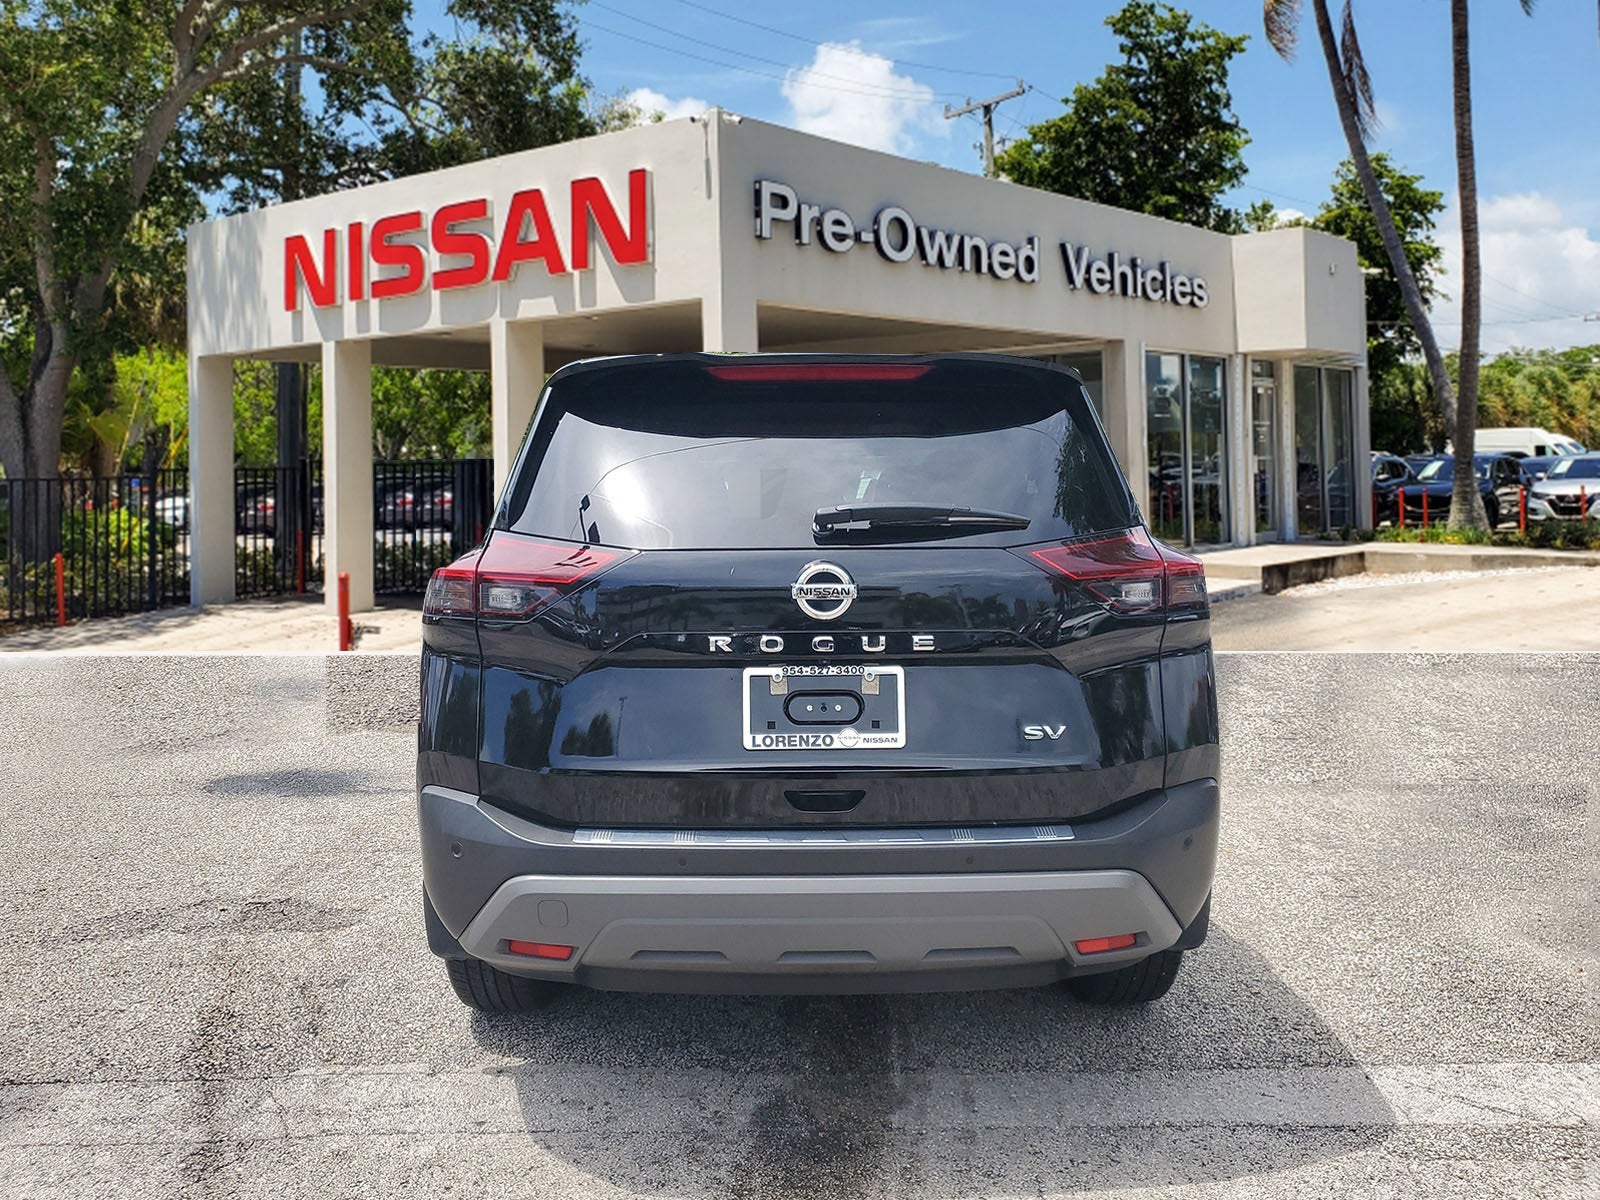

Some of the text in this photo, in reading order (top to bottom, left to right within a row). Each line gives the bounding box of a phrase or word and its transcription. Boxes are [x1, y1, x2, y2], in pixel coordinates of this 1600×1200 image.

[285, 168, 649, 312] NISSAN
[754, 179, 1209, 308] Pre-Owned Vehicles
[799, 587, 850, 596] NISSAN
[708, 635, 936, 652] ROGUE
[782, 666, 865, 676] 954-527-3400
[1024, 725, 1067, 740] SV
[752, 734, 834, 748] LORENZO
